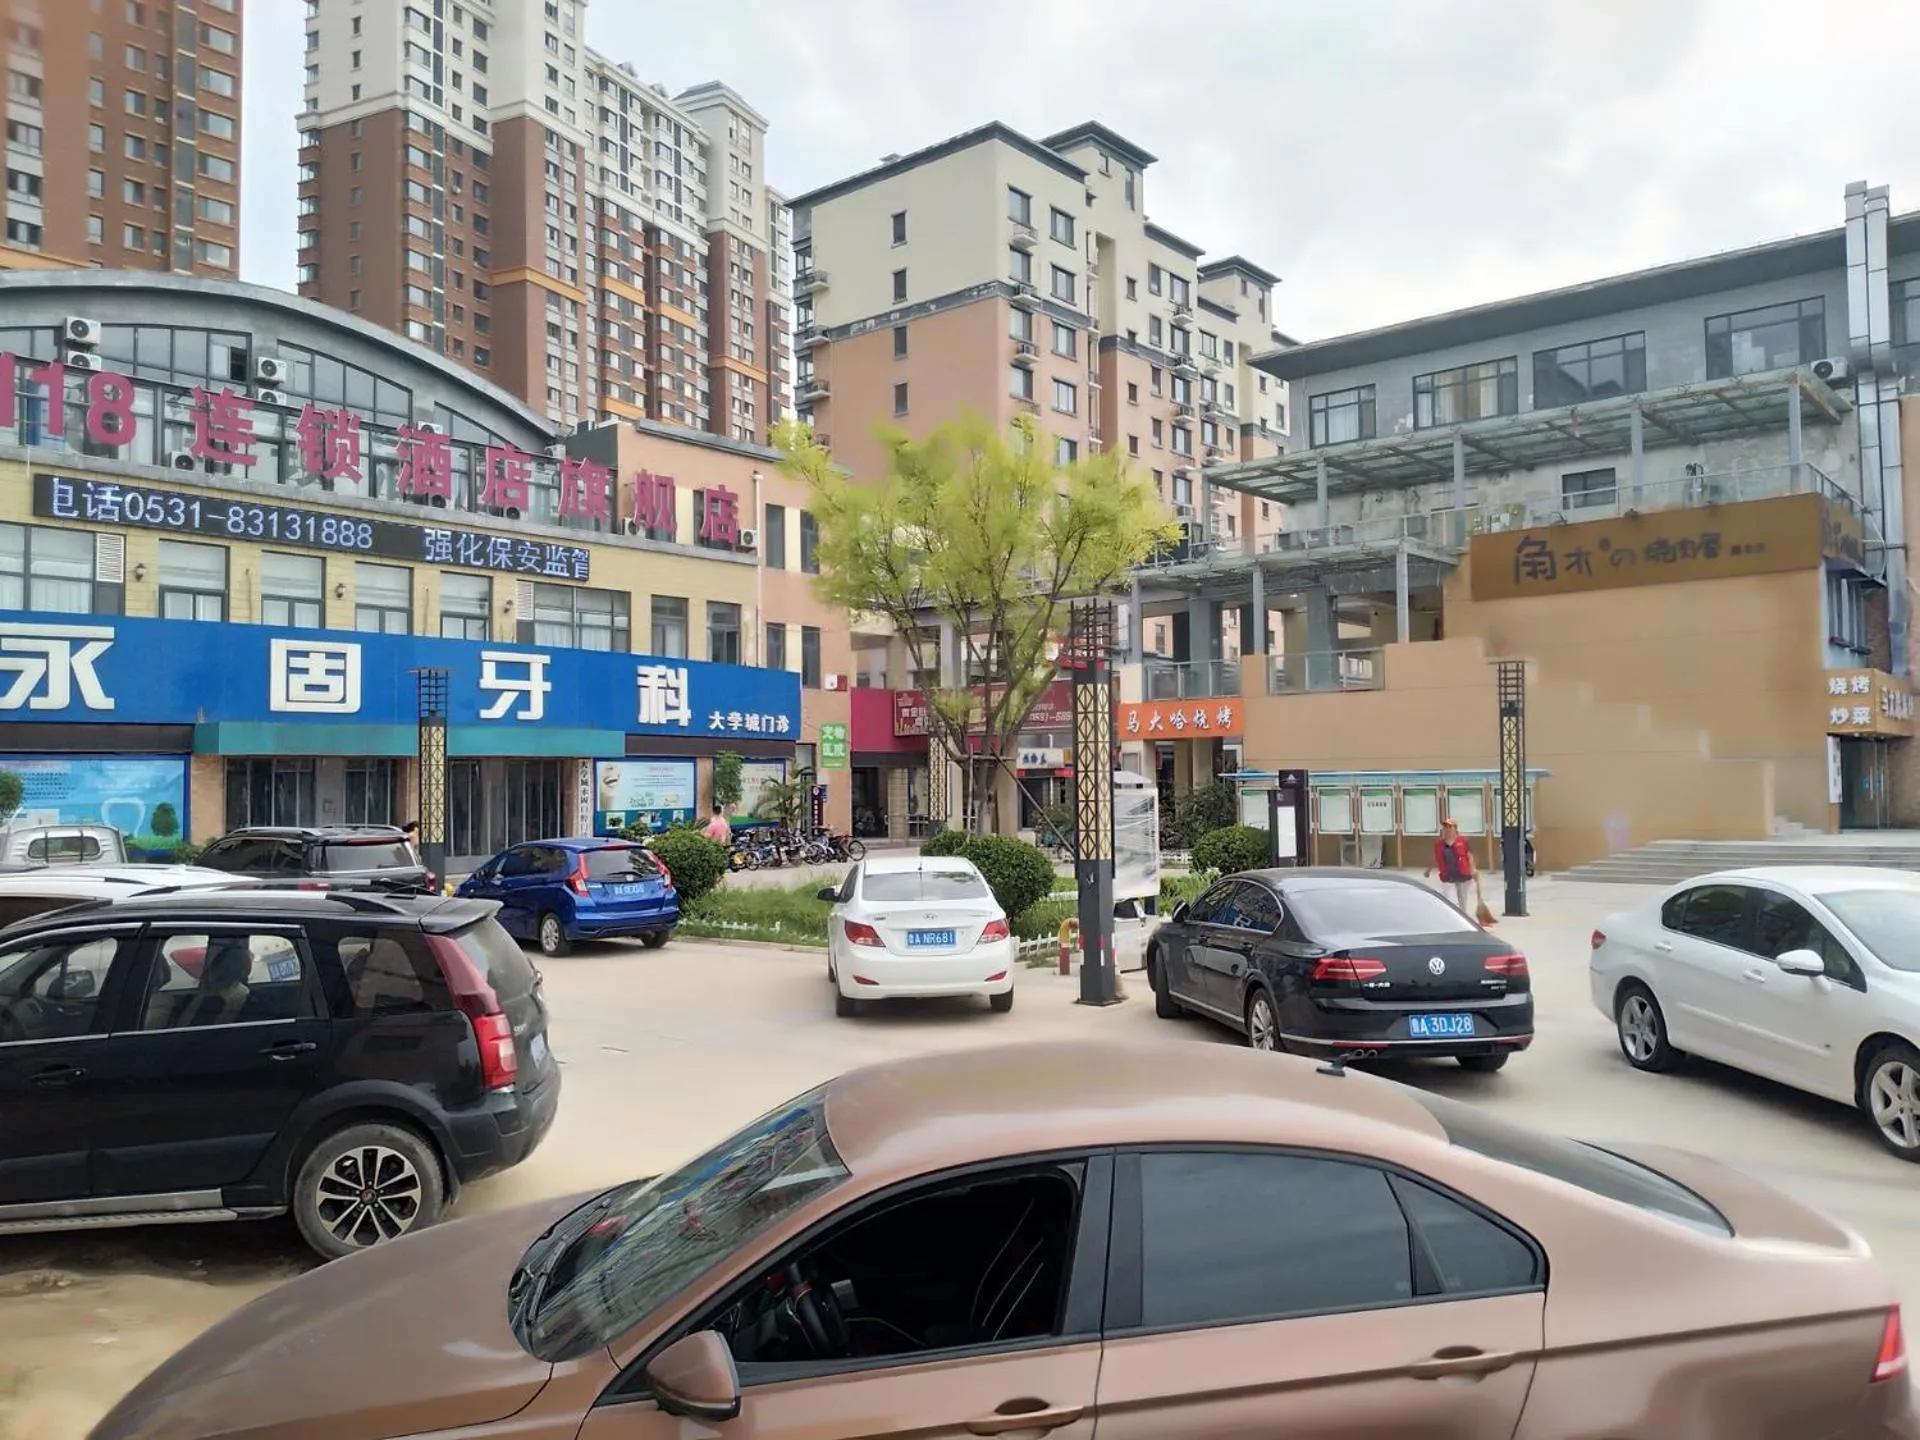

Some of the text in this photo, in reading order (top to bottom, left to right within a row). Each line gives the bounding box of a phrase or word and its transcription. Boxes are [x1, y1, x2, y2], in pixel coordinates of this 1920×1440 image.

[424, 527, 589, 578] 强化保安监管
[0, 621, 692, 727] 永固牙科
[1828, 675, 1871, 695] 烧烤
[708, 710, 790, 734] 大学城门诊
[1829, 706, 1872, 725] 炒菜
